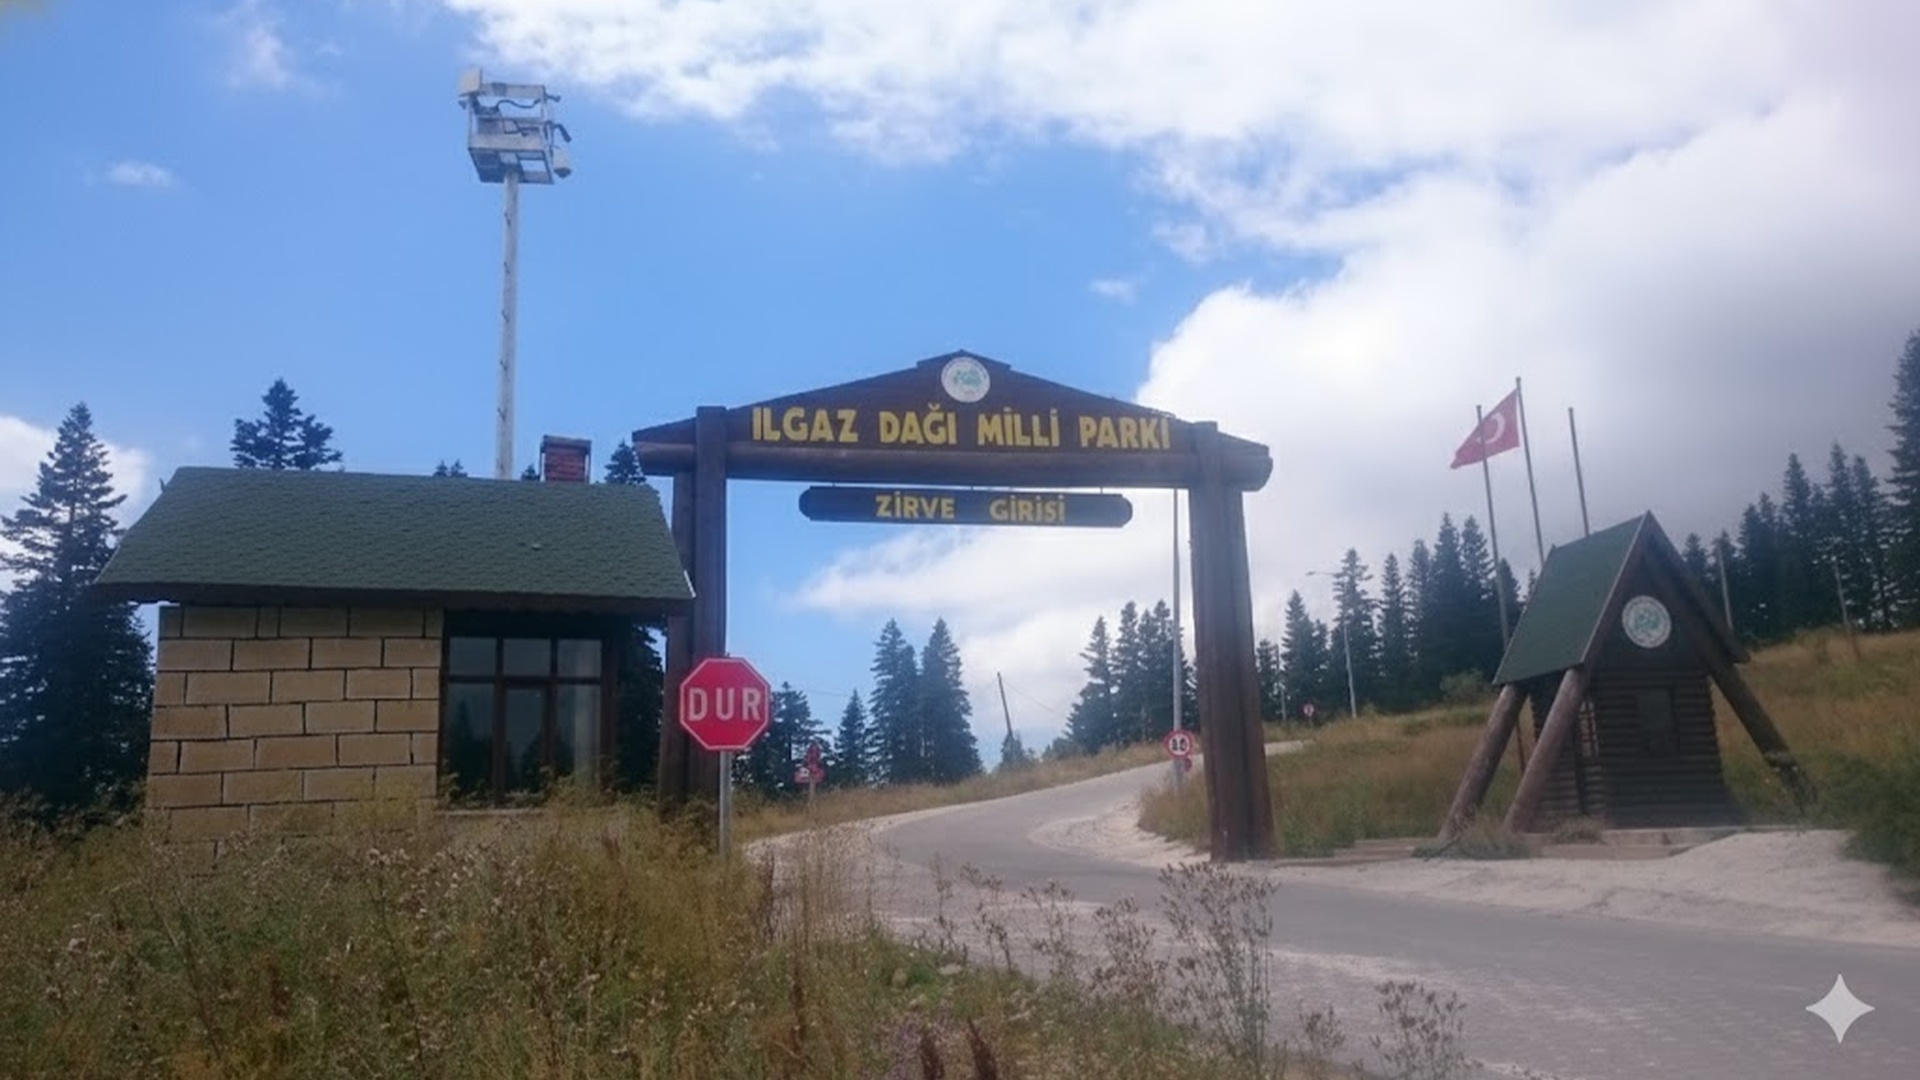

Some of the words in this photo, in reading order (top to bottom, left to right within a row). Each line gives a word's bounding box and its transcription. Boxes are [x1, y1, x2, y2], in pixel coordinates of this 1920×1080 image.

[752, 406, 860, 443] ILGAZ
[879, 402, 957, 445] DAĞI
[977, 406, 1060, 447] MİLLİ
[875, 490, 955, 519] ZİRVE
[688, 687, 761, 721] DUR
